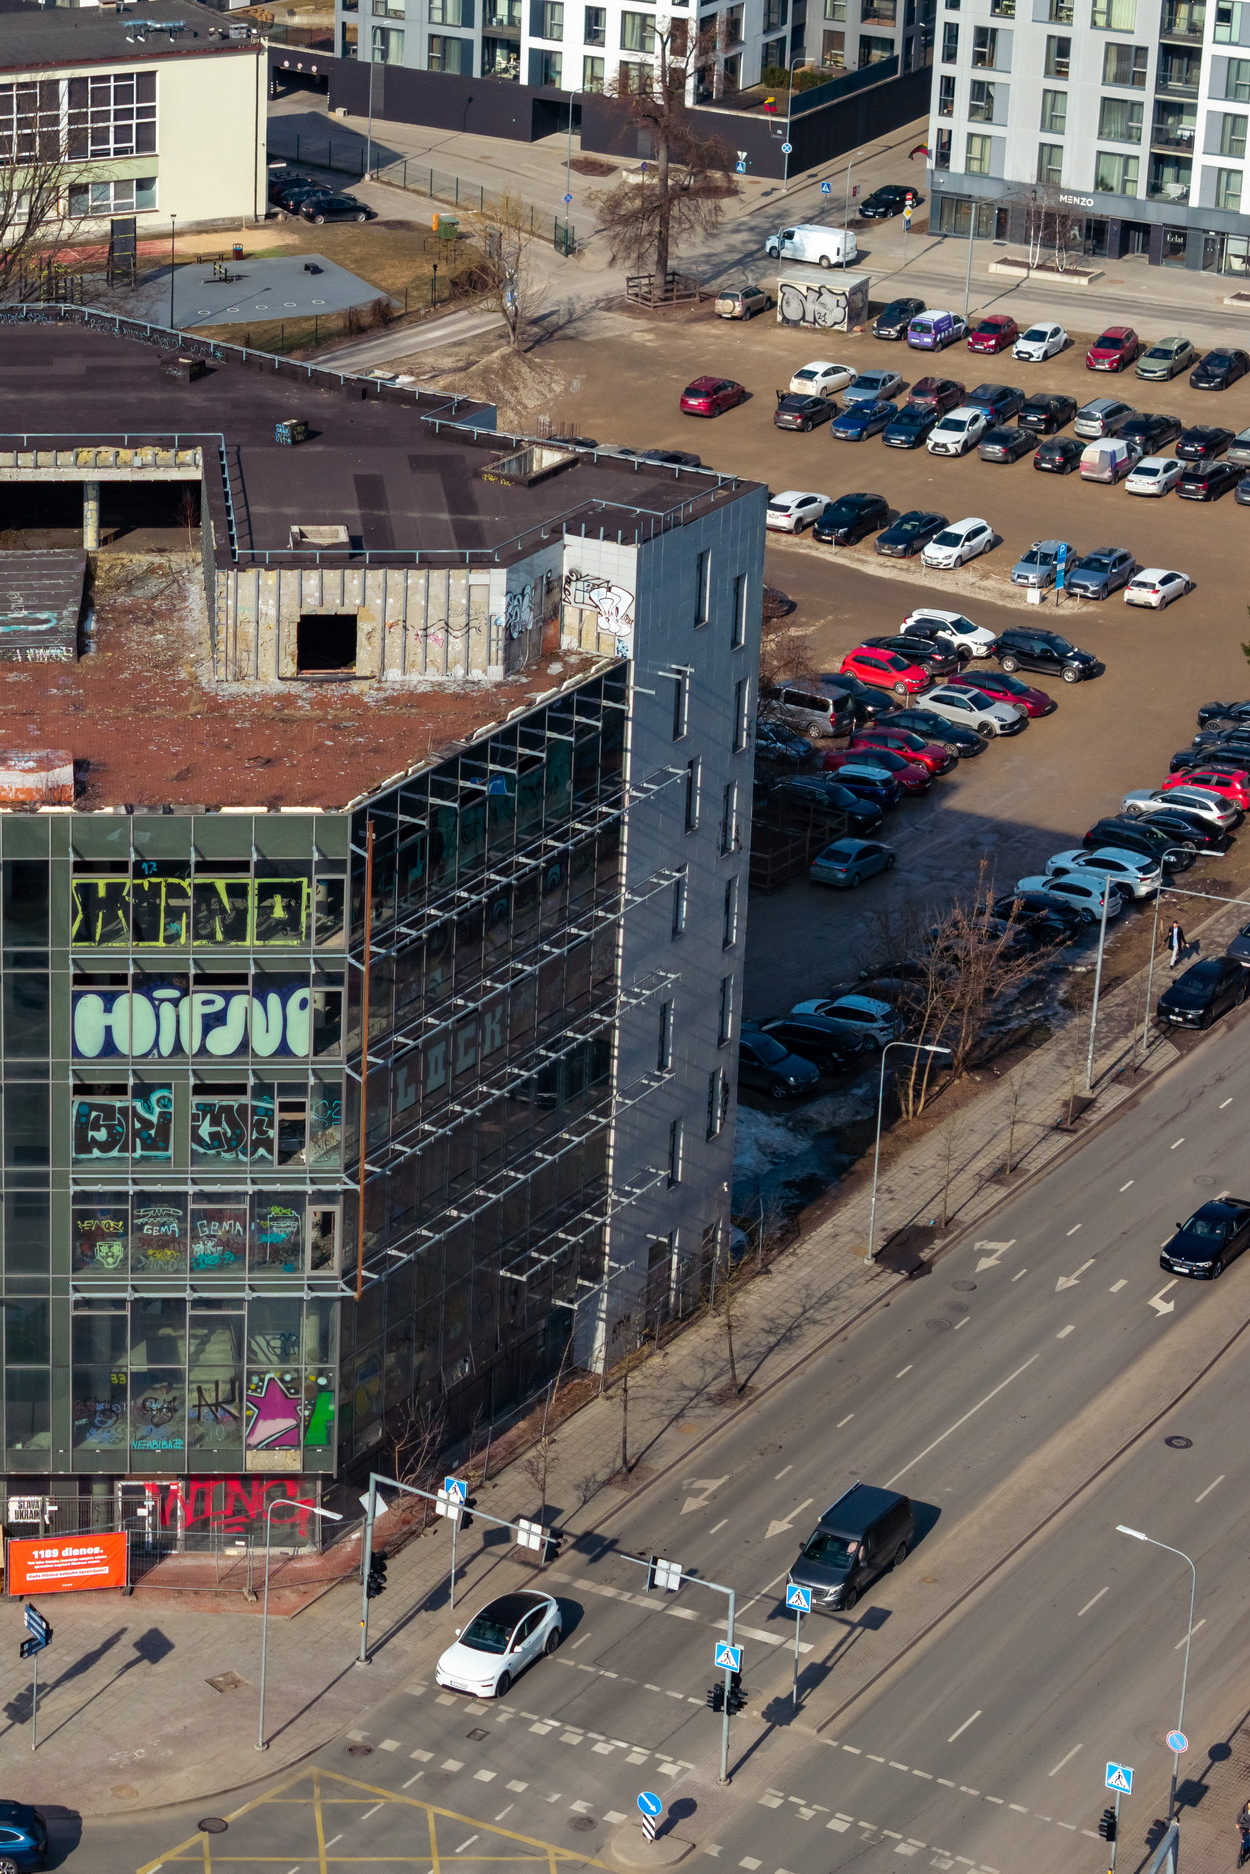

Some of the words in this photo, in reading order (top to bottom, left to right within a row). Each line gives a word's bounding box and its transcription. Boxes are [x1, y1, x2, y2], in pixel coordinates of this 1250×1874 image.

[1059, 194, 1094, 207] MENZO
[1166, 232, 1184, 243] Éclat
[143, 1223, 179, 1238] GEMA
[32, 1548, 59, 1559] 1189
[62, 1546, 104, 1557] dienos.
